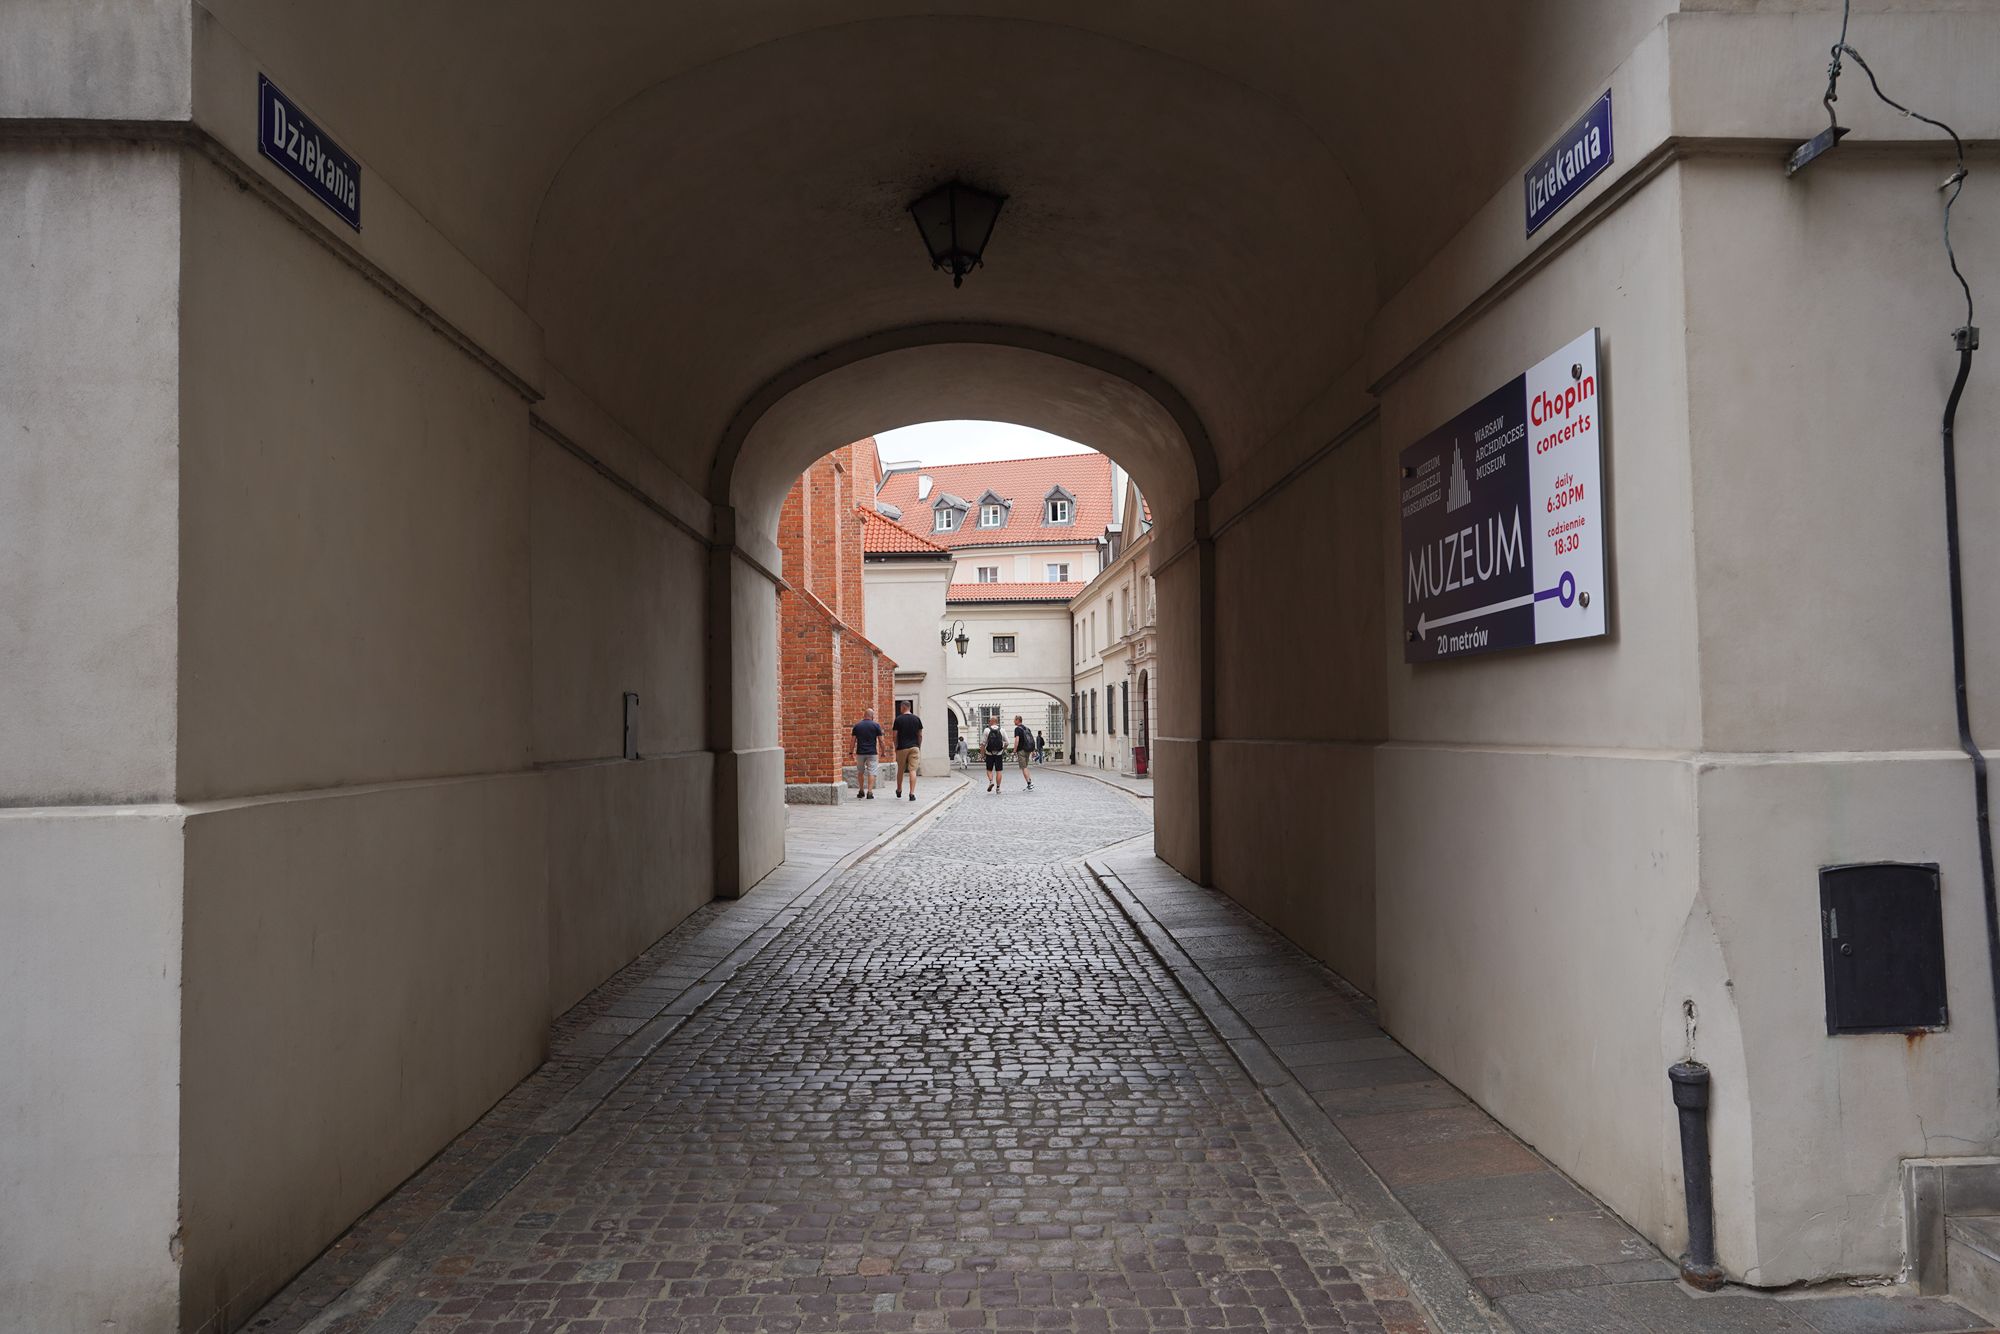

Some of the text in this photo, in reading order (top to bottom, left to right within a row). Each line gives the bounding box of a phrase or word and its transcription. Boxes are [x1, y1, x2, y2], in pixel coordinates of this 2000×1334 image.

[273, 98, 356, 211] Dziekania
[1529, 120, 1601, 219] Dziekania
[1531, 376, 1594, 427] Chopin
[1474, 415, 1504, 443] WARSAW
[1475, 423, 1525, 462] ARCHDIOCESE
[1537, 415, 1590, 455] concerts
[1476, 453, 1506, 480] MUSEUM
[1554, 472, 1574, 489] daily
[1546, 483, 1584, 513] 6:30 PM
[1547, 515, 1585, 538] codziennie
[1408, 503, 1526, 604] MUZEUM
[1554, 533, 1579, 556] 18:30
[1437, 626, 1489, 655] 20 metrów
